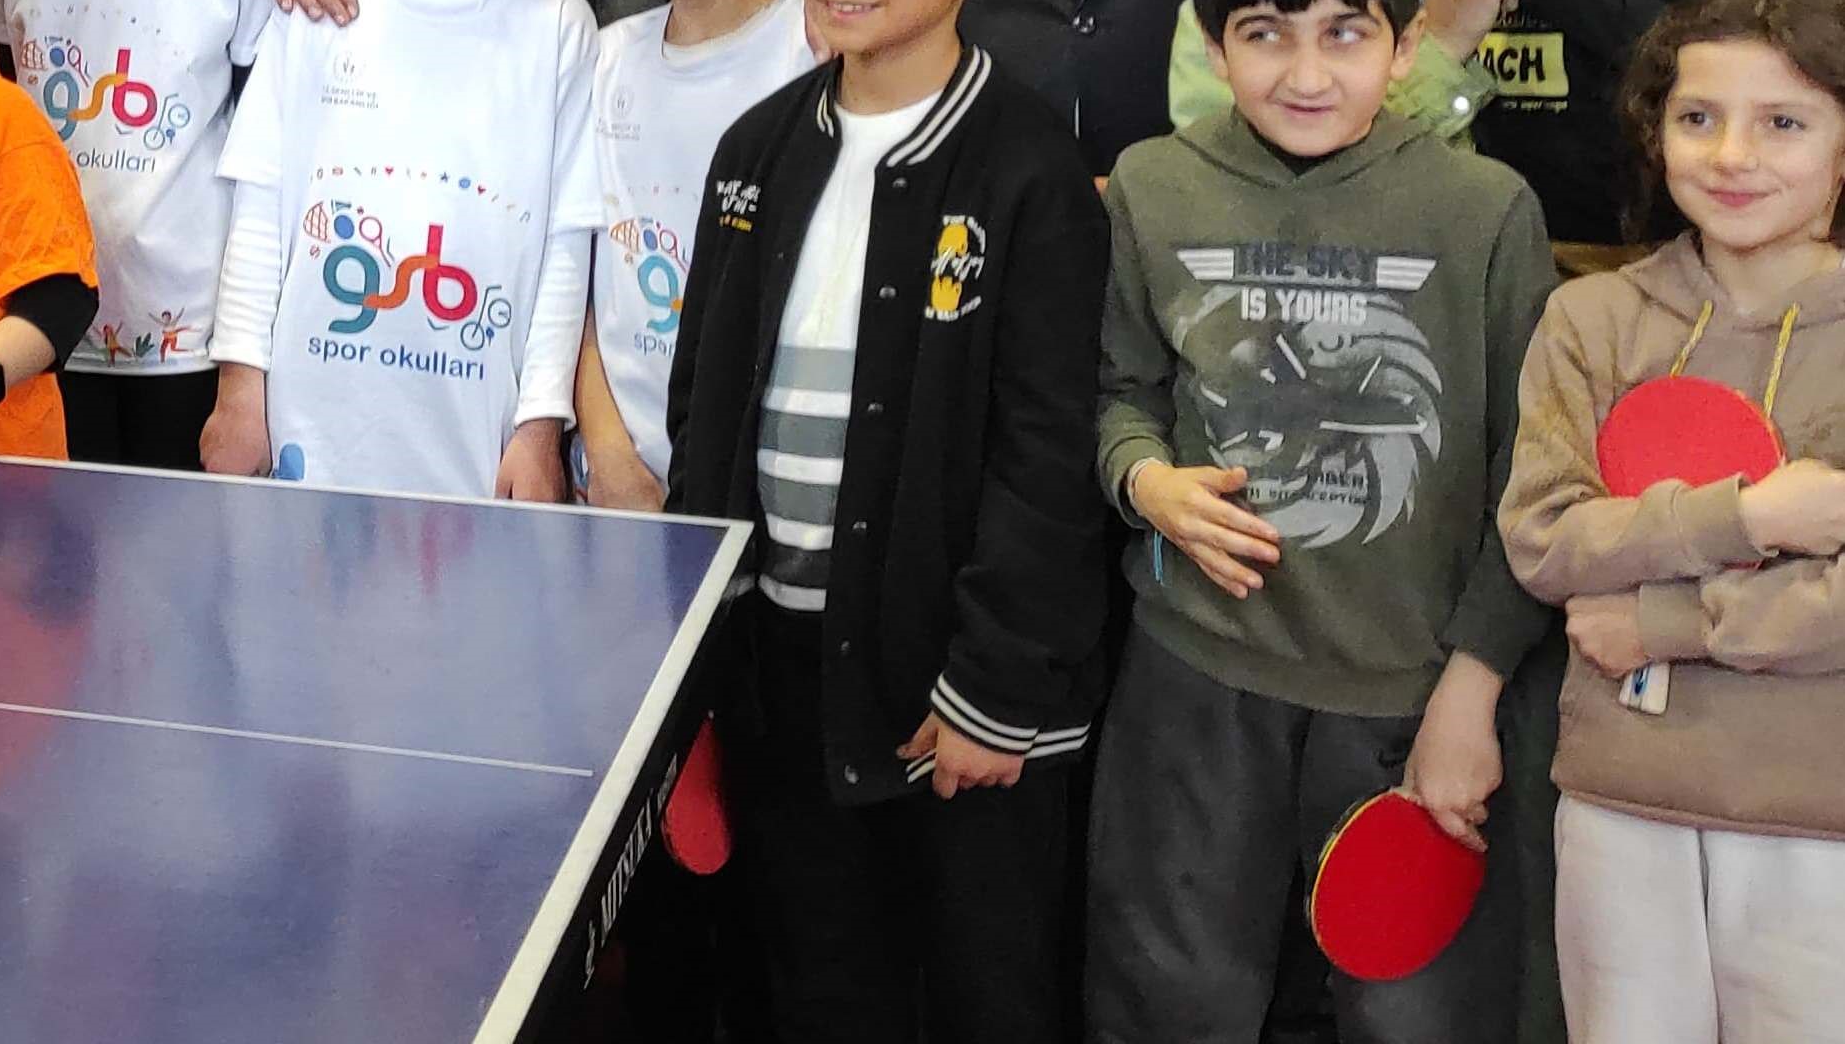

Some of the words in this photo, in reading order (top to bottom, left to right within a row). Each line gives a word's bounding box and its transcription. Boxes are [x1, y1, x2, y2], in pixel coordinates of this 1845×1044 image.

[1240, 285, 1267, 322] IS
[1274, 287, 1368, 326] YOURS
[308, 336, 371, 363] spor
[379, 344, 485, 381] okulları
